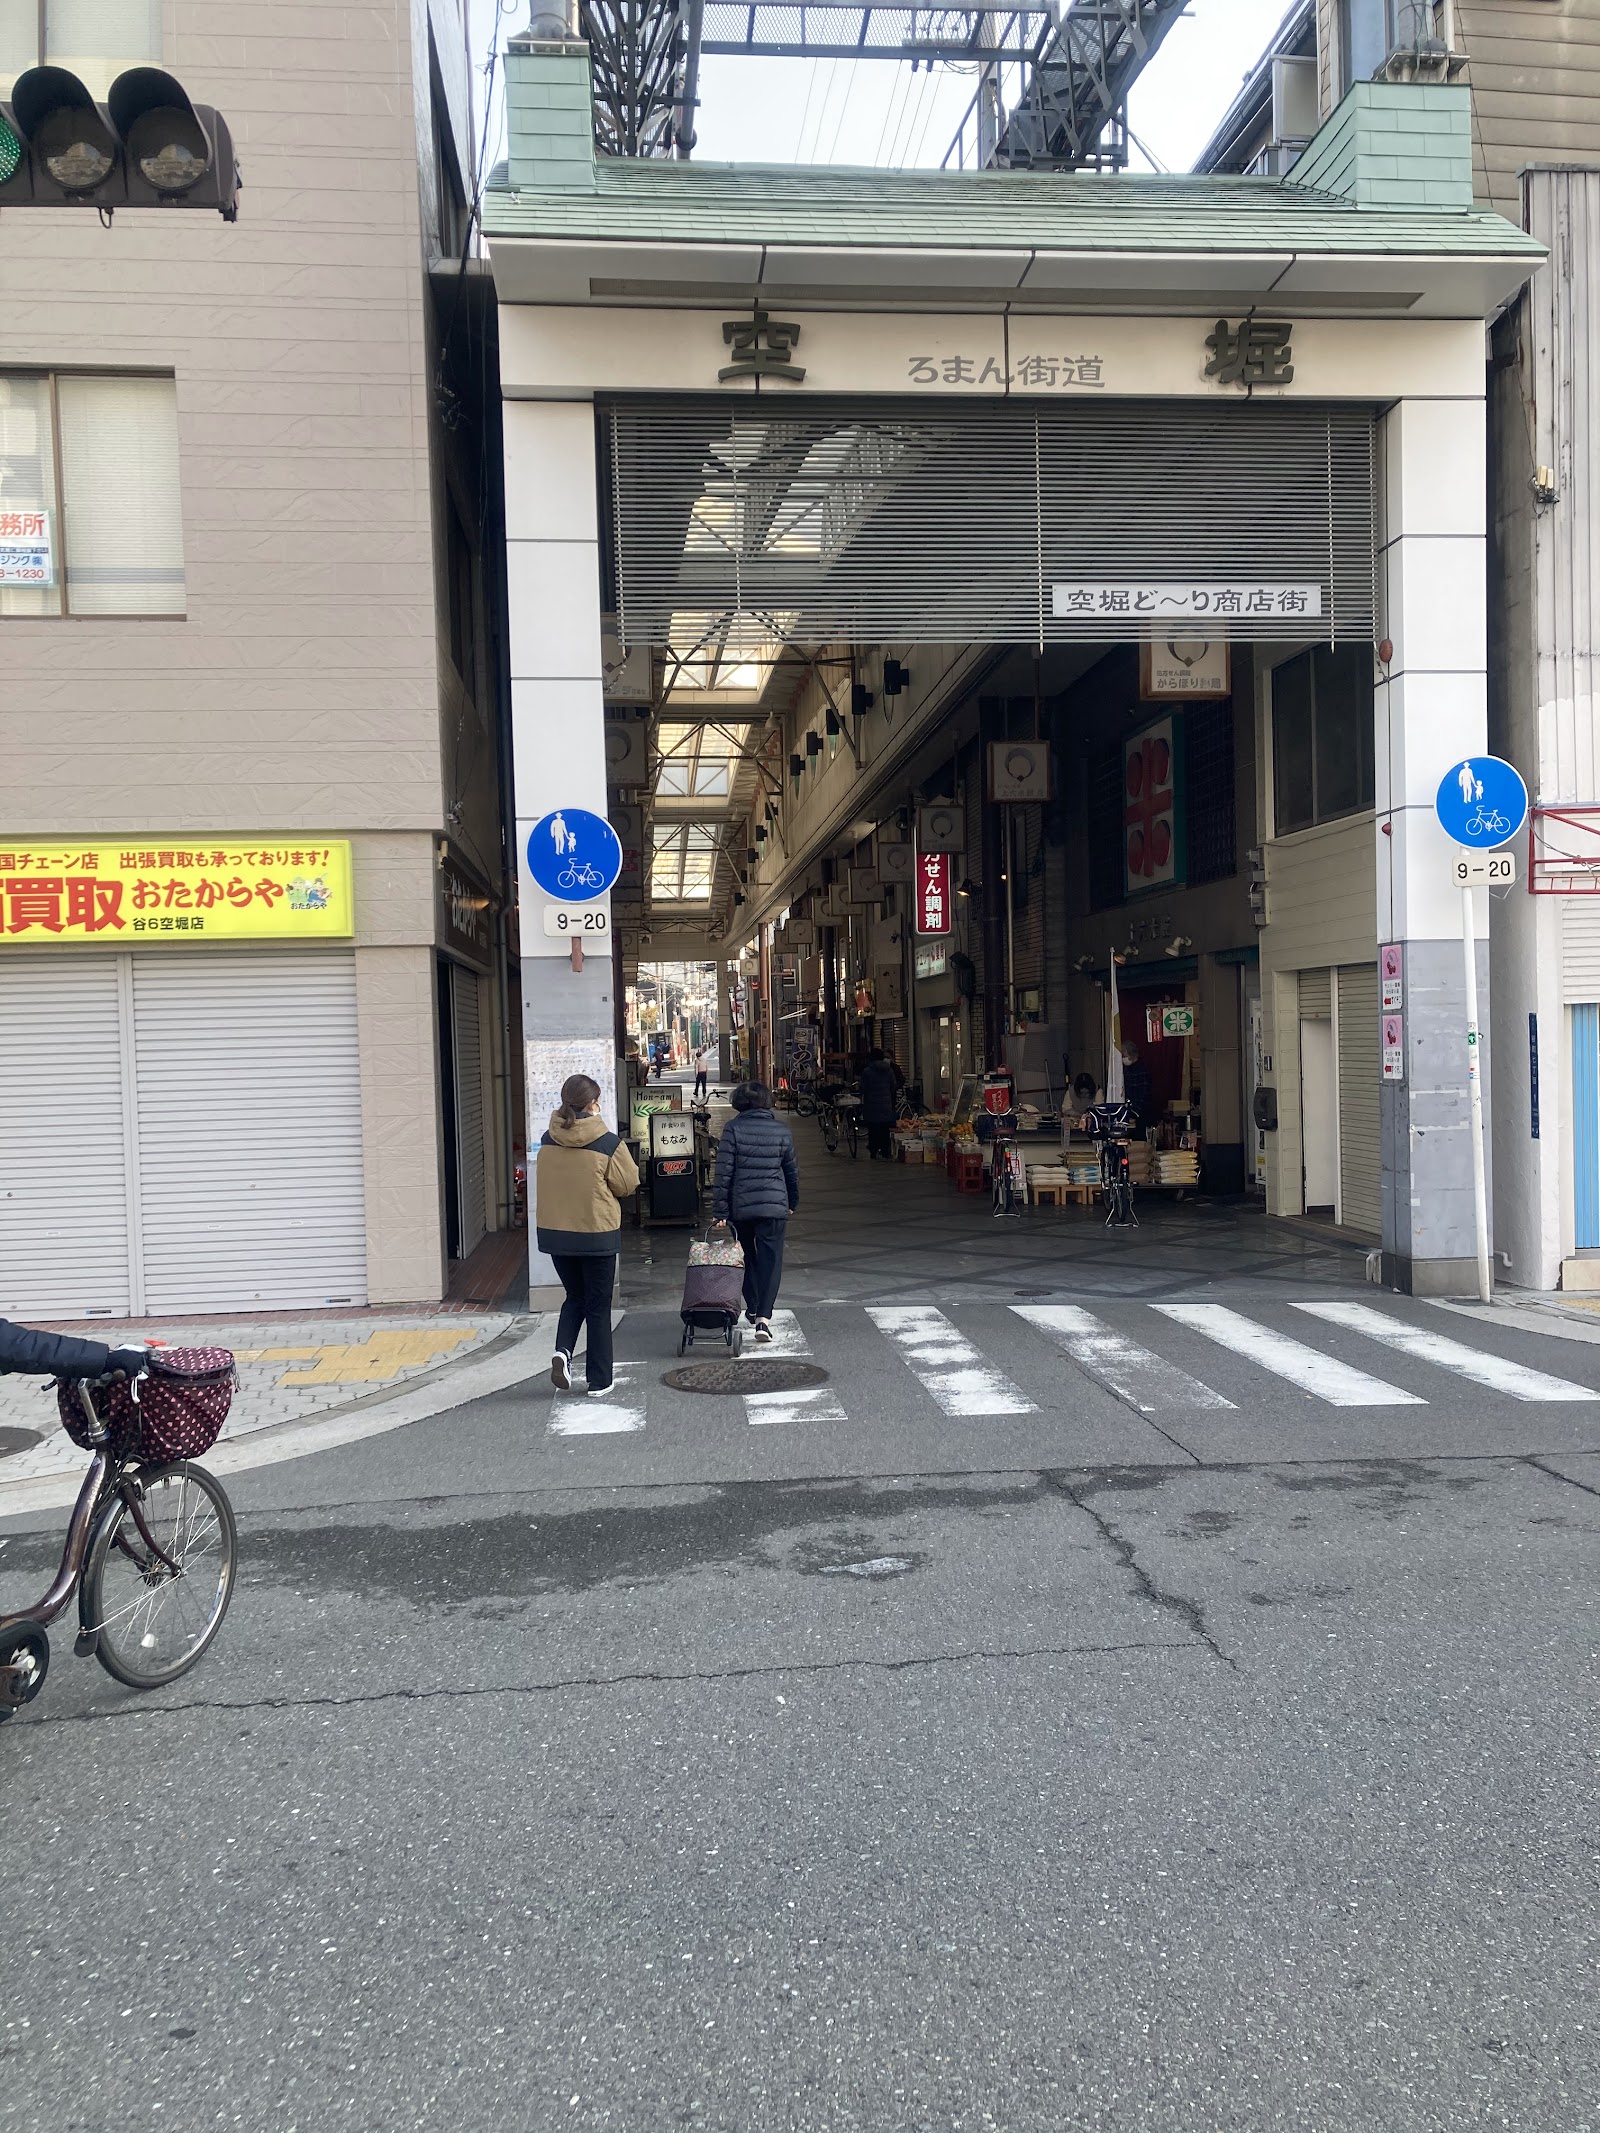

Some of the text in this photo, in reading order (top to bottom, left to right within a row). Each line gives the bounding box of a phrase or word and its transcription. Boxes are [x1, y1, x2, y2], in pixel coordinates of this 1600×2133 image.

[717, 311, 1295, 386] 空 堀
[908, 354, 1106, 388] ろまん街道
[1456, 859, 1512, 880] 9-20
[131, 877, 285, 909] おたからや
[132, 915, 205, 932] 谷6空堀店
[557, 912, 606, 930] 9-20
[660, 1135, 688, 1145] もなみ
